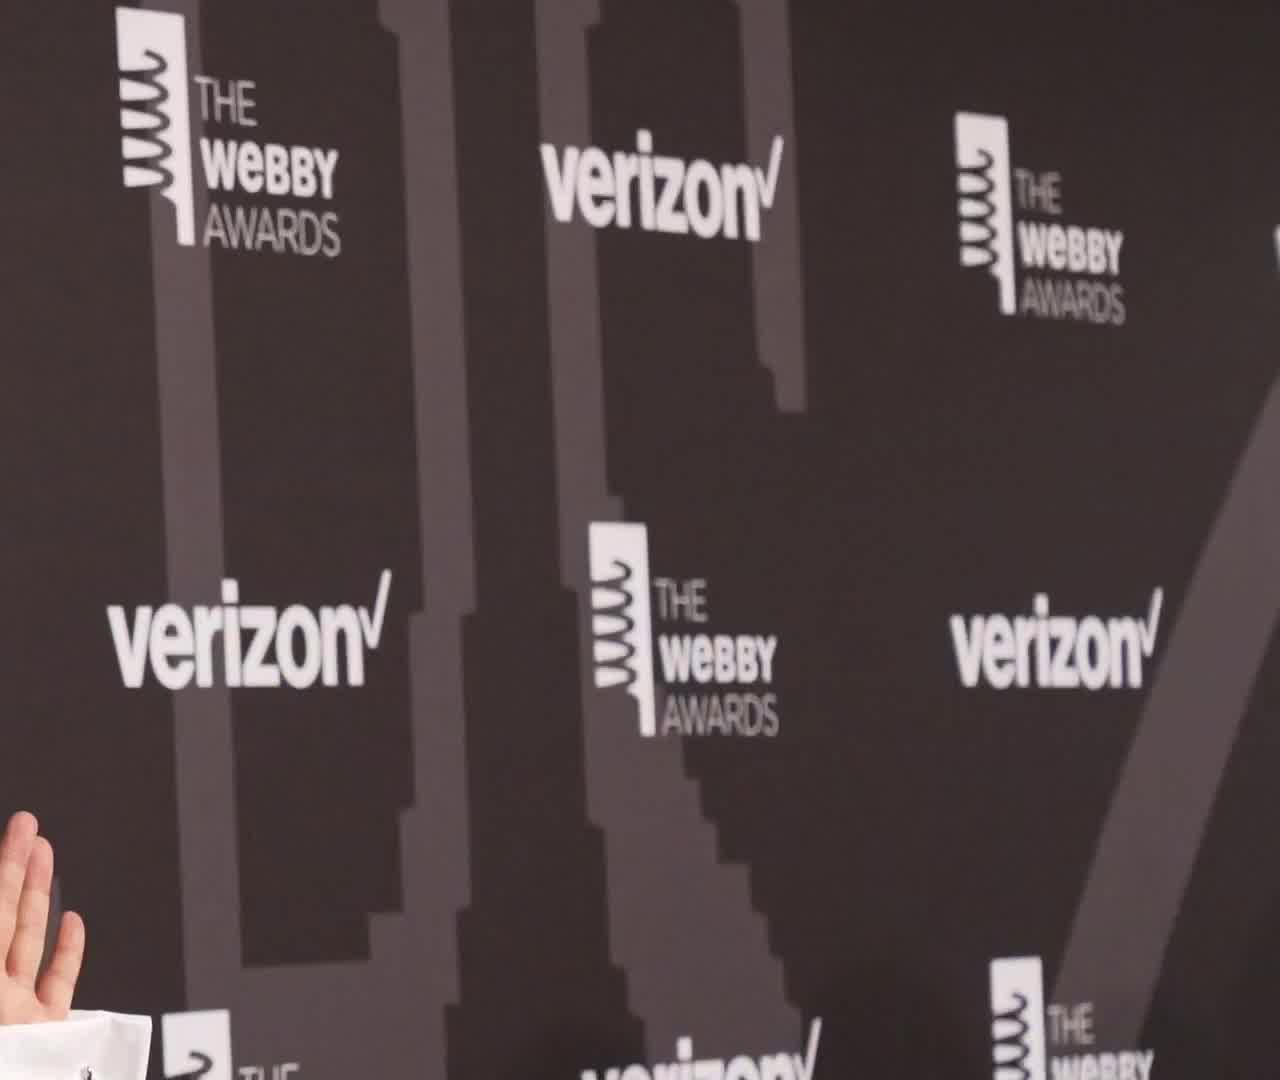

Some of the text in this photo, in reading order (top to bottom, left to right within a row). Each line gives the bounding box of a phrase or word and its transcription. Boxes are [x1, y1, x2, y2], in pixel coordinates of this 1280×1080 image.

[194, 75, 257, 127] THE
[200, 138, 338, 199] WeBBY
[540, 130, 762, 241] verizon
[1015, 168, 1061, 214] THE
[202, 204, 341, 257] AWARDS
[1018, 221, 1123, 276] WeBBY
[1020, 278, 1126, 325] AWARDS
[655, 577, 707, 623] THE
[107, 577, 366, 690] verizon
[659, 633, 777, 684] WeBBY
[950, 594, 1144, 690] verizon
[661, 693, 779, 738] AWARDS
[1047, 1002, 1093, 1044] THE
